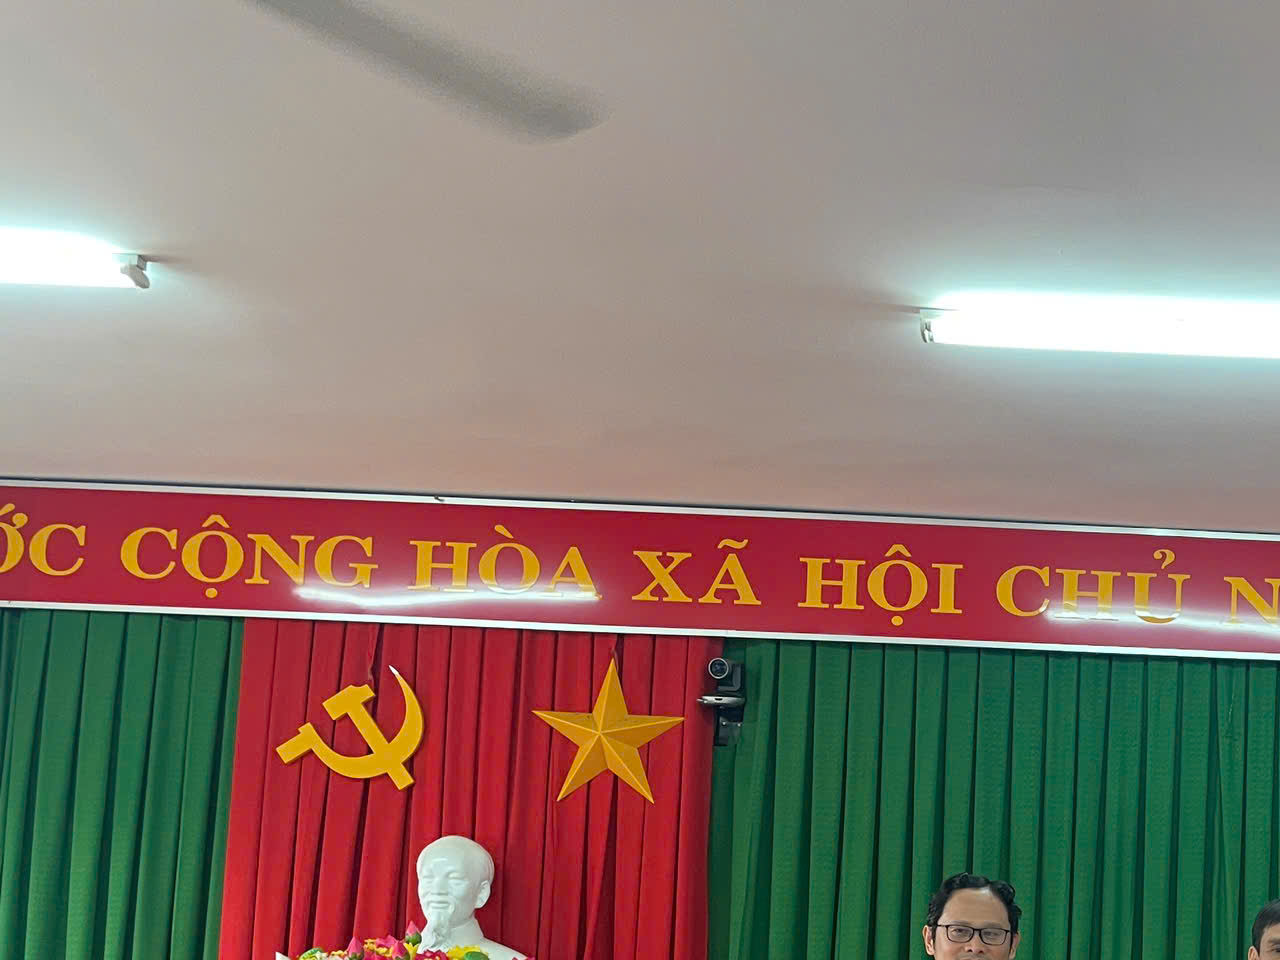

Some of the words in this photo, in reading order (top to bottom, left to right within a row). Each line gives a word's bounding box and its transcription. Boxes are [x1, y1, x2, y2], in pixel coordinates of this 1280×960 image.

[120, 515, 378, 598] CỘNG
[409, 525, 601, 600] HÒA
[631, 539, 762, 605] XÃ
[800, 544, 962, 627] HỘI
[995, 549, 1191, 624] CHỦ
